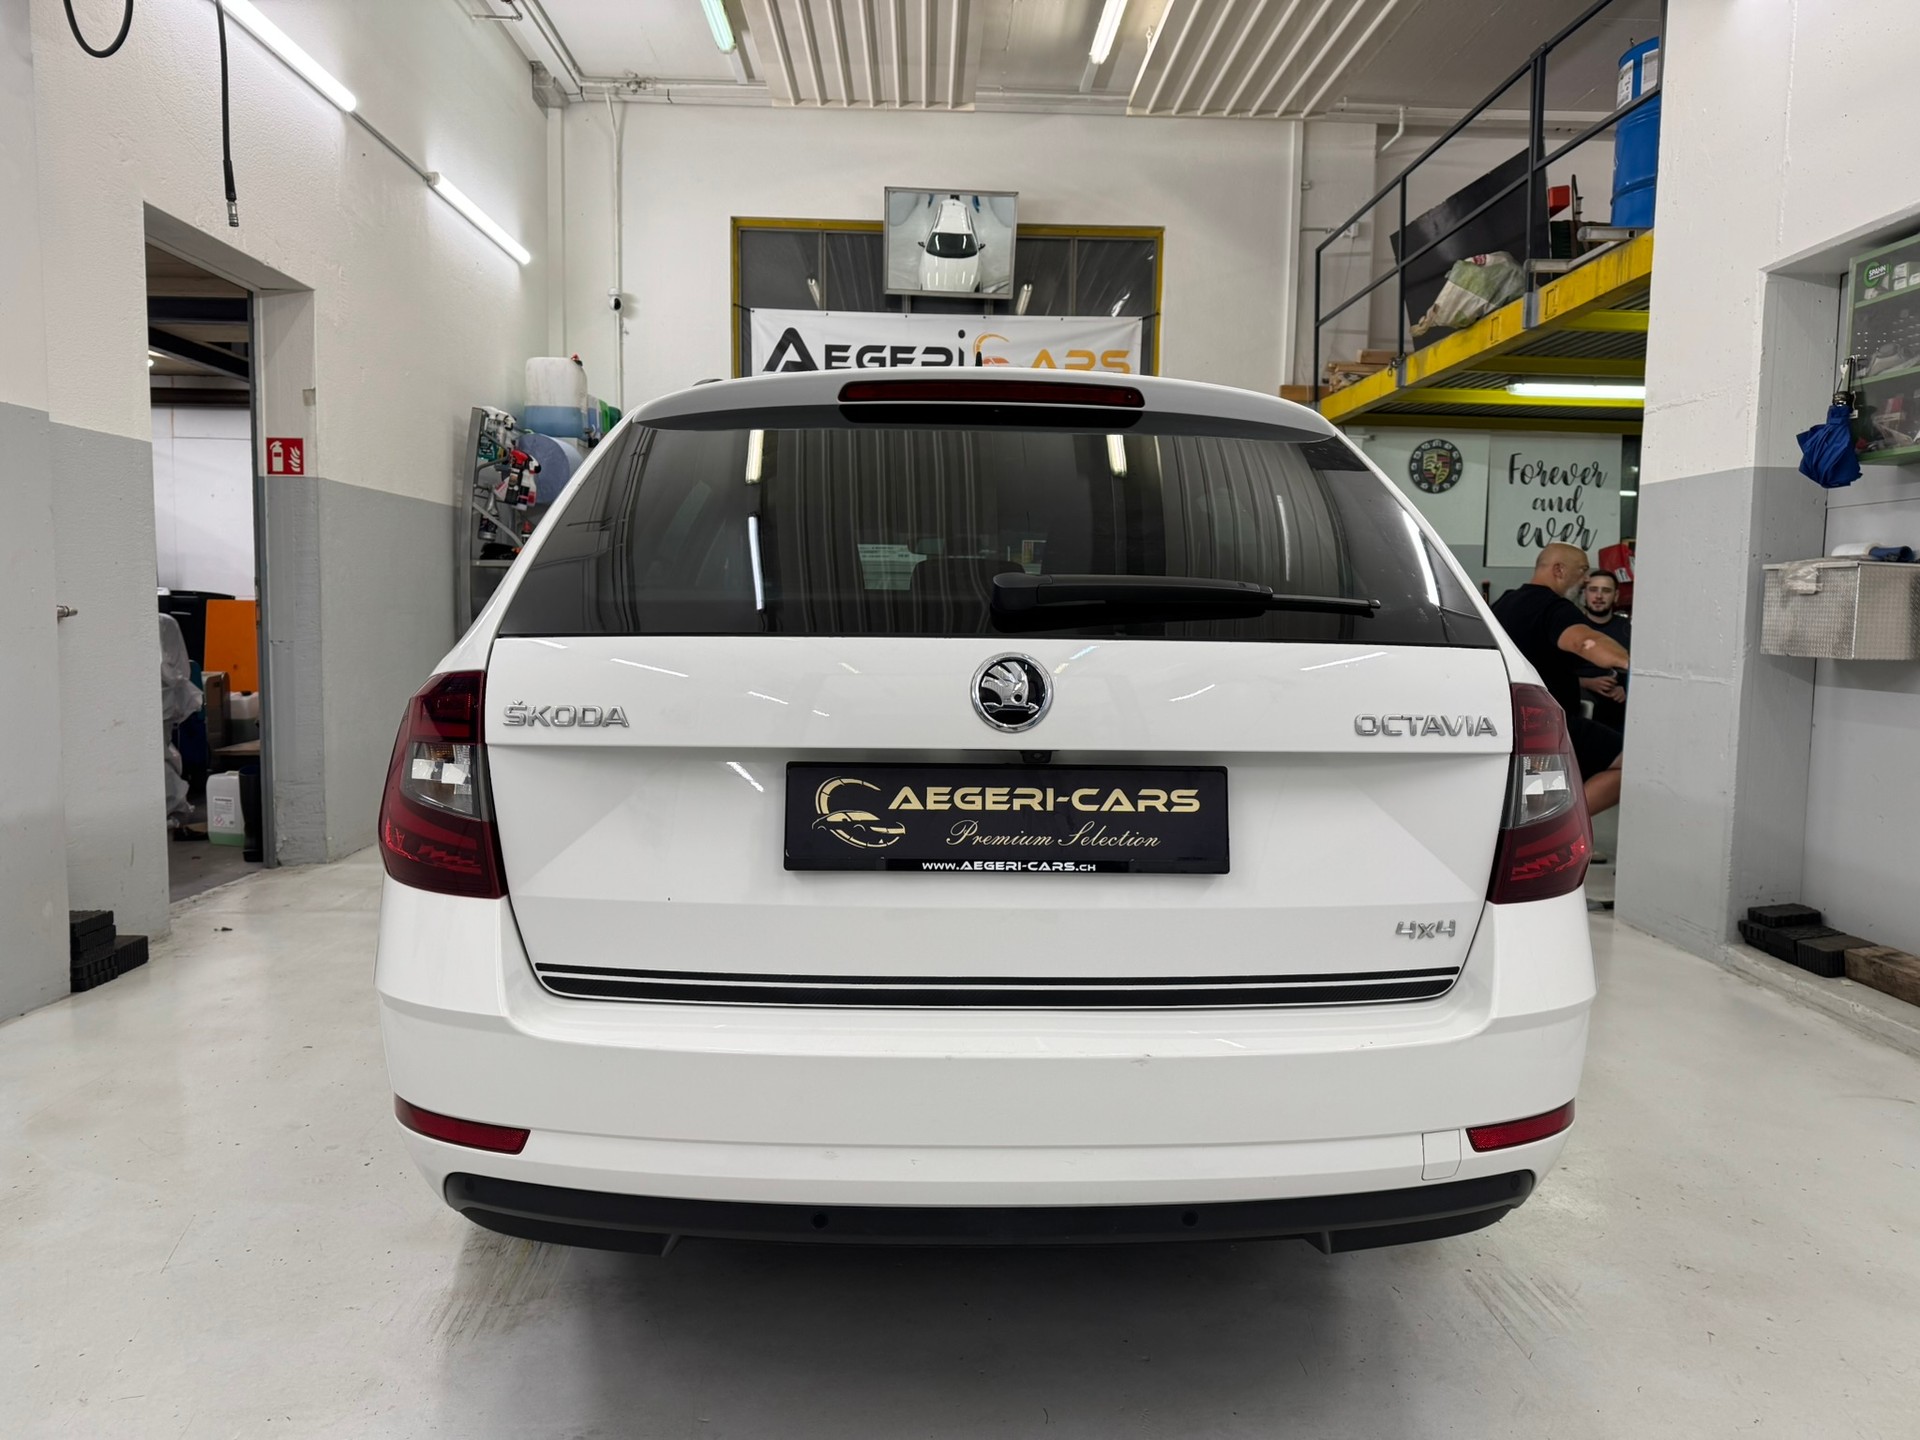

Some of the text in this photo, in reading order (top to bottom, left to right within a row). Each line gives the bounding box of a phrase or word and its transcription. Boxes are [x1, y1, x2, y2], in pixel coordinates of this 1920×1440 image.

[1508, 452, 1608, 488] Forever
[1532, 485, 1584, 513] and
[1516, 515, 1598, 551] ever
[503, 700, 630, 727] ŠKODA
[1354, 713, 1498, 737] OCTAVIA
[887, 786, 1201, 813] AEGERI-CARS
[946, 819, 1161, 847] Premium Selection
[1395, 919, 1456, 940] 4x4
